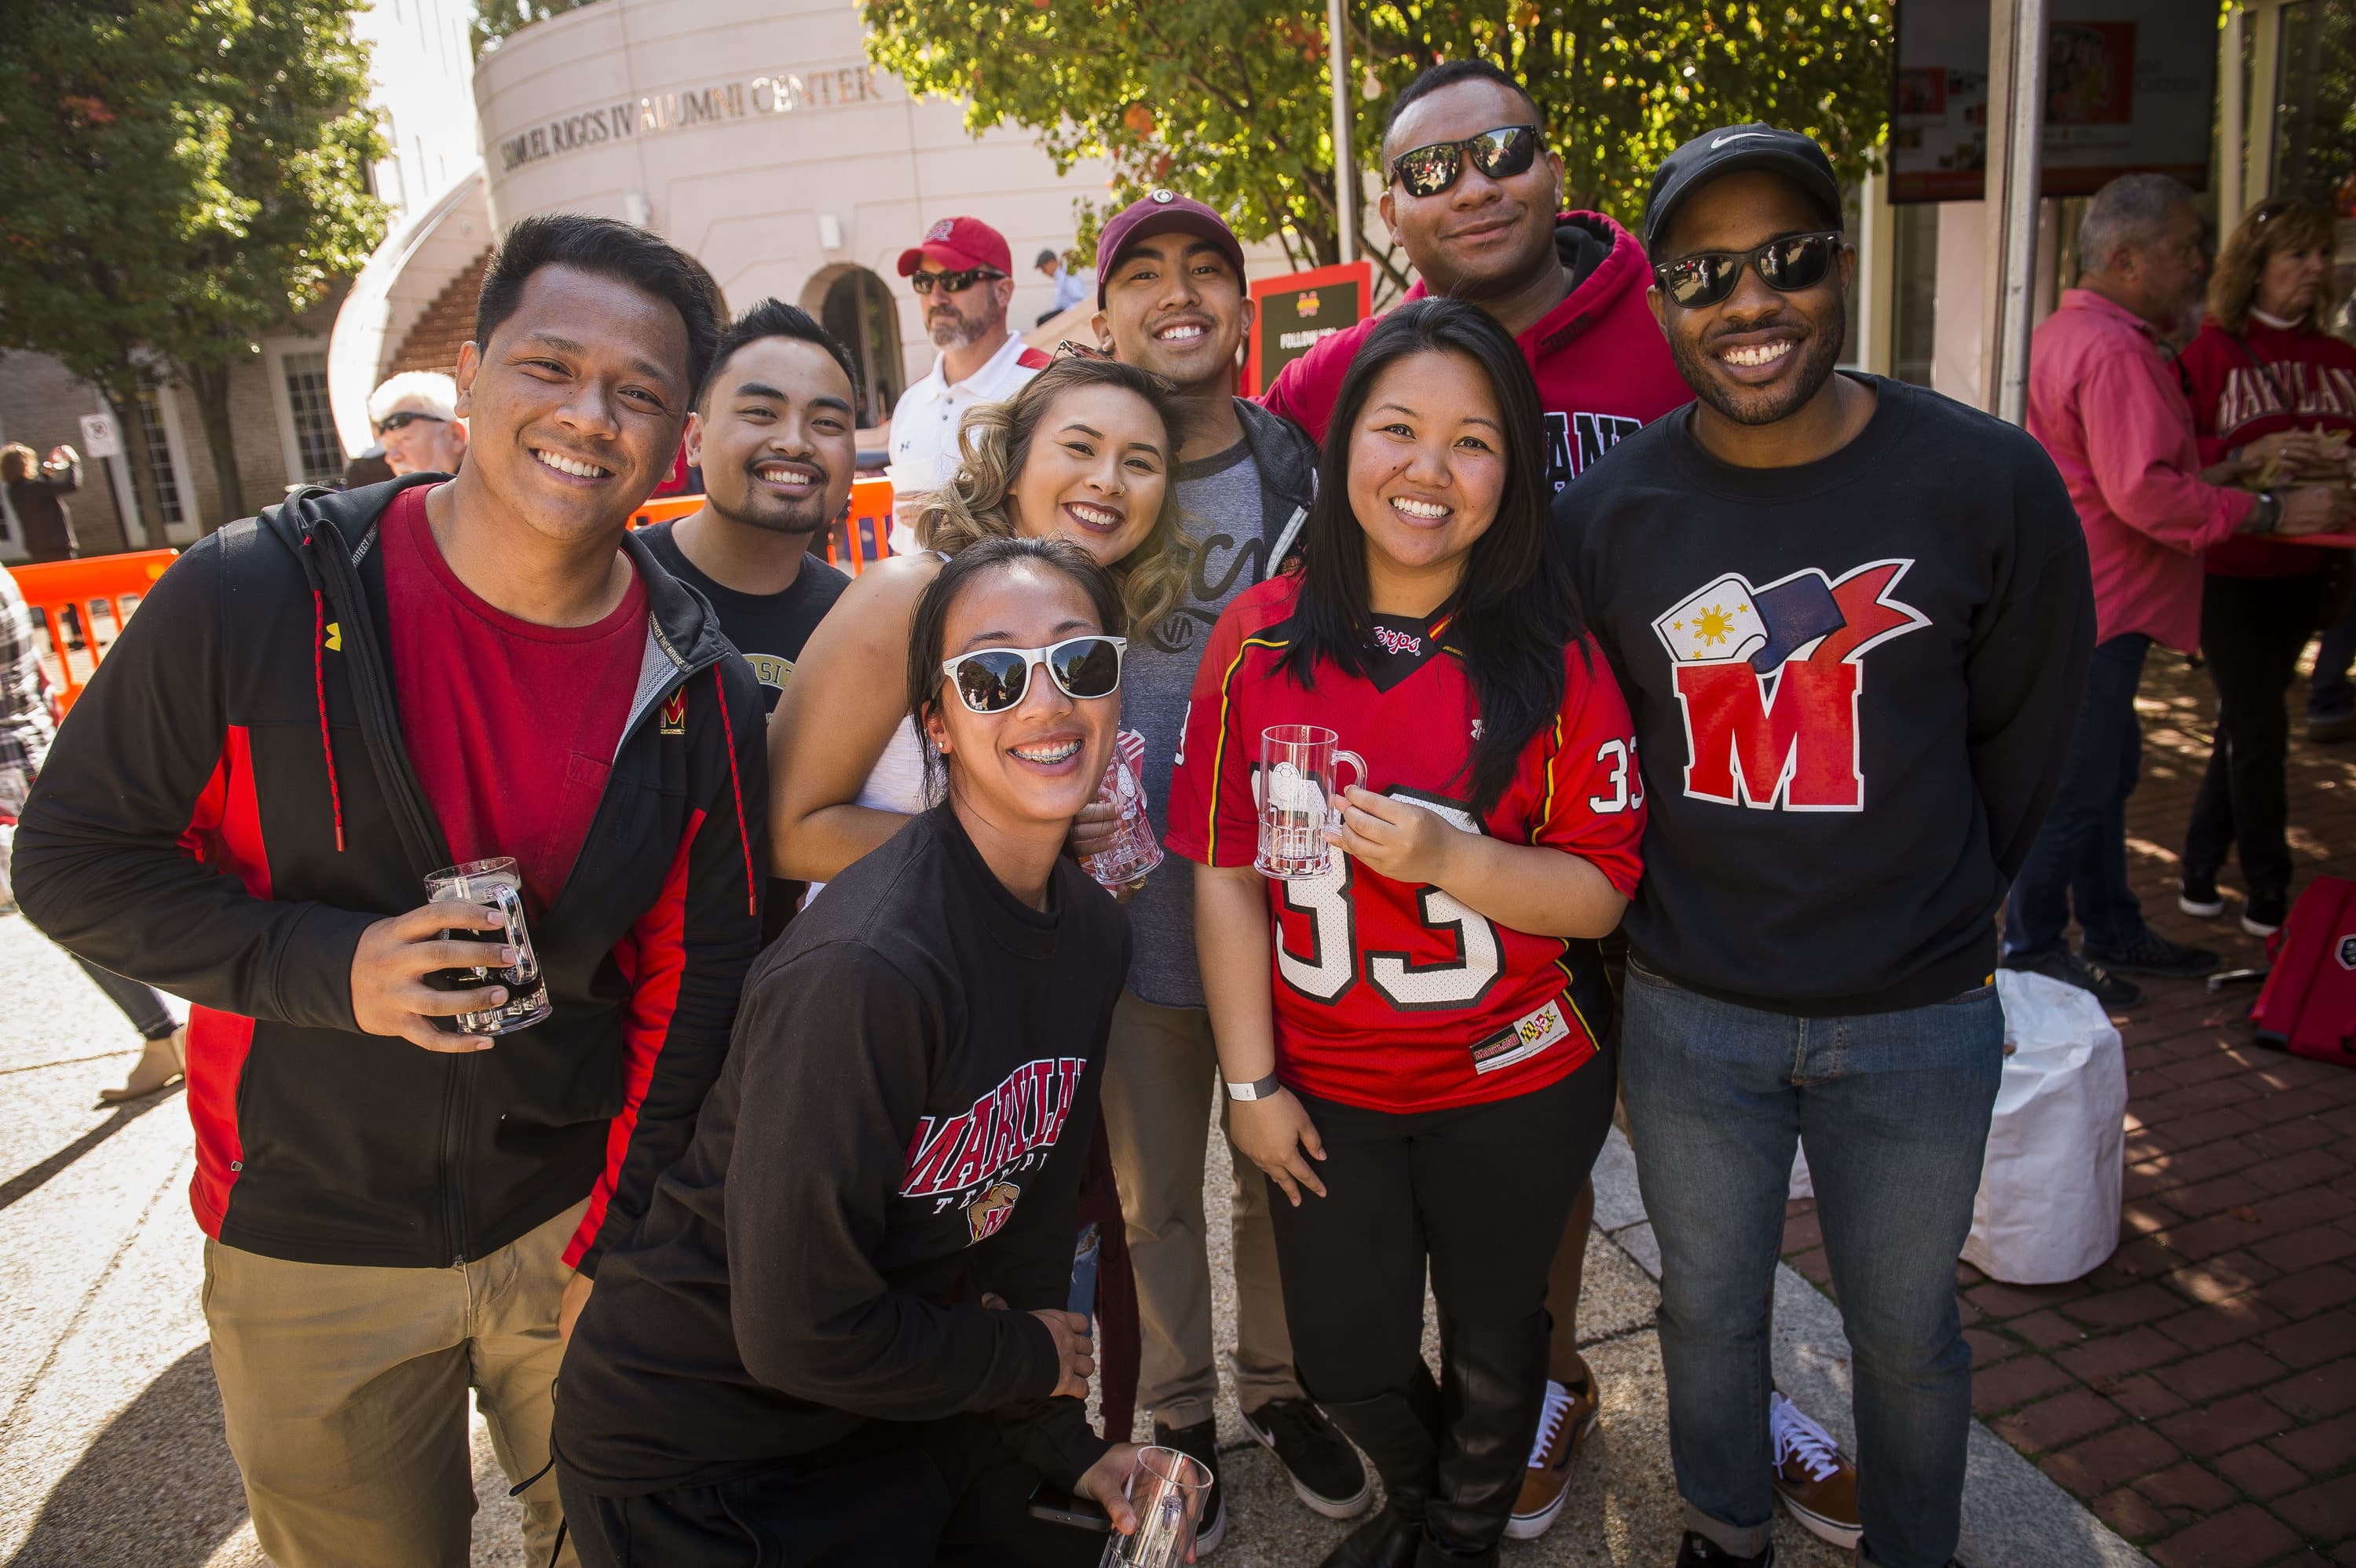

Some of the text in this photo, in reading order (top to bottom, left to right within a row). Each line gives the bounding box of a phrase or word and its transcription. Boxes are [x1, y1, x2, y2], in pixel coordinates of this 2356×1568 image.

[610, 101, 635, 139] IV
[640, 82, 744, 132] ALUMNI
[752, 65, 883, 114] CENTER
[666, 646, 685, 667] HOUSE
[1672, 660, 1864, 812] M
